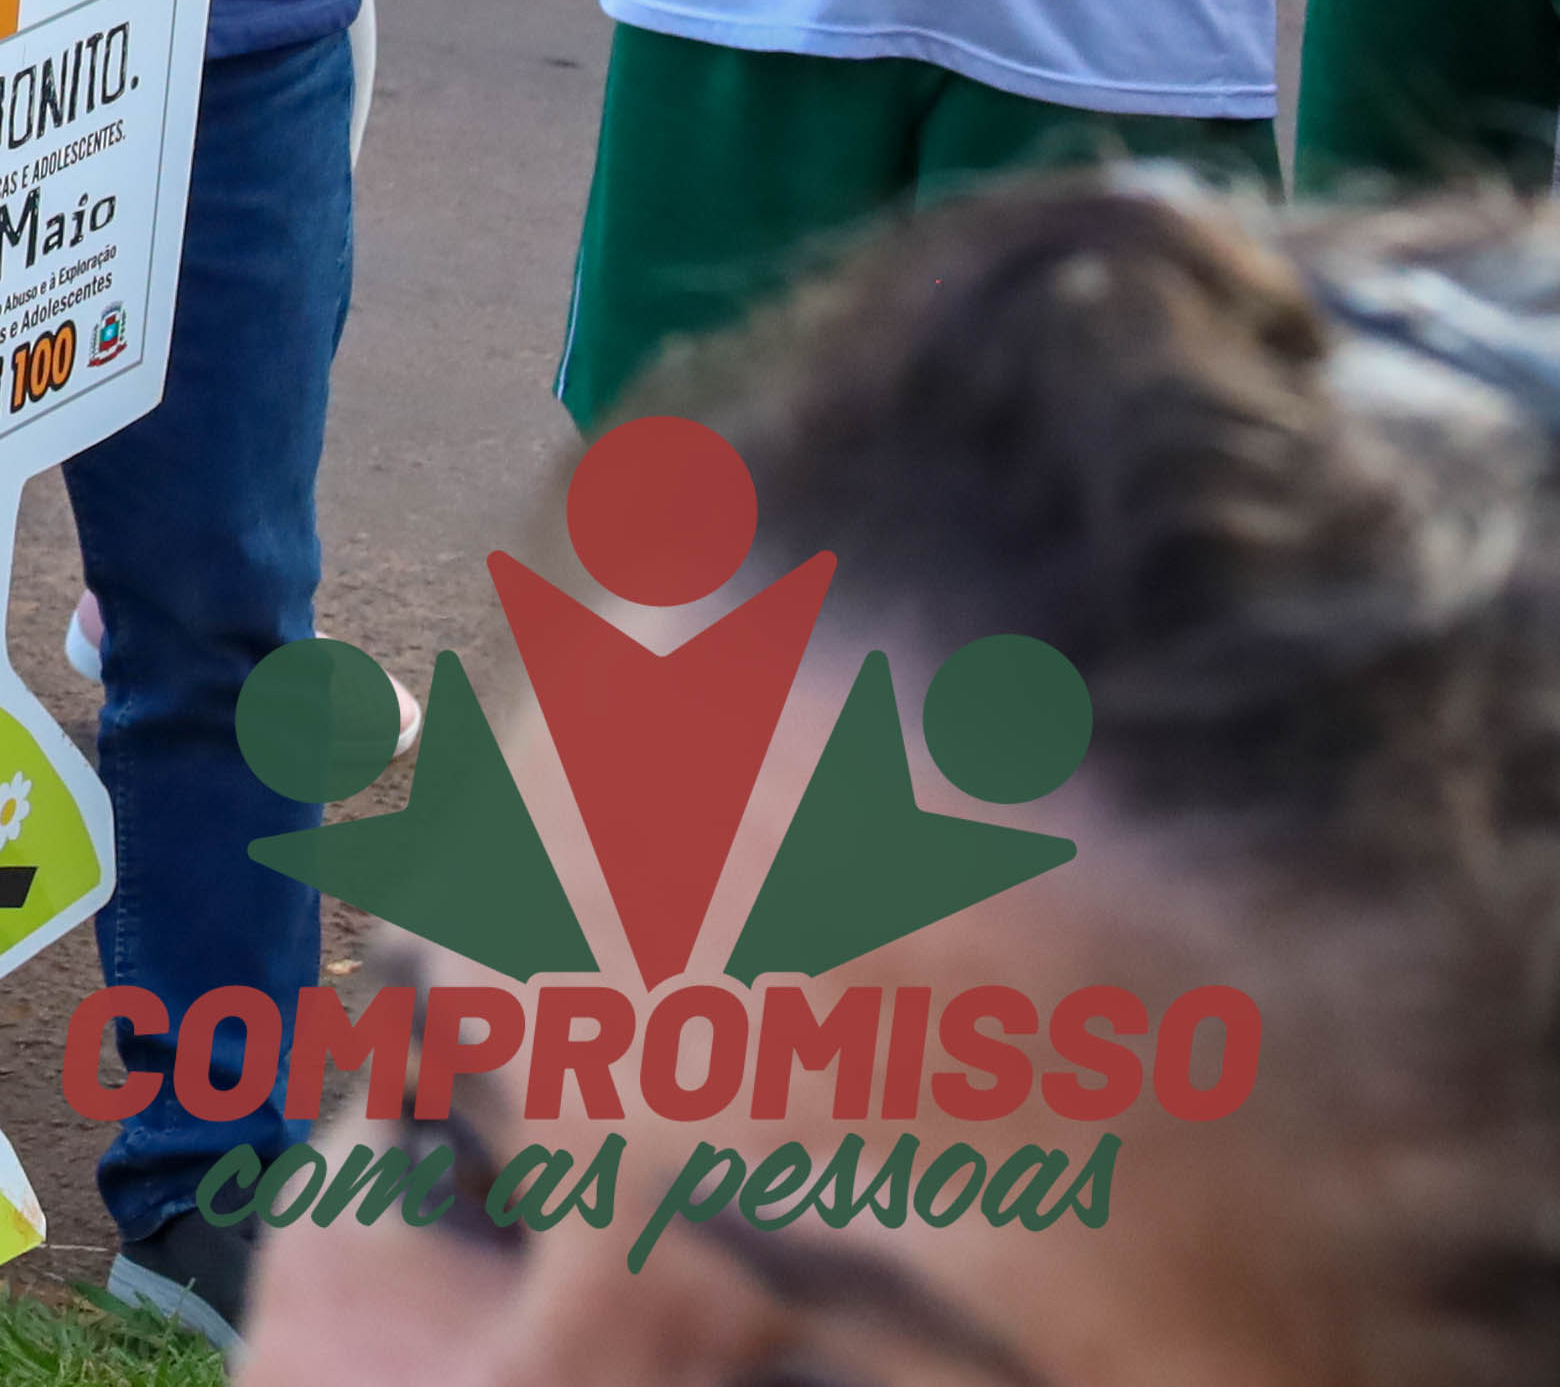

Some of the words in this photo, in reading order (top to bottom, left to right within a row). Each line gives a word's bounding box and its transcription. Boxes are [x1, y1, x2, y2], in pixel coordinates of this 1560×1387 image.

[21, 164, 29, 189] E
[4, 286, 38, 314] Abuso
[40, 280, 47, 295] e
[49, 272, 56, 291] à
[59, 245, 117, 285] Exploração
[10, 320, 18, 338] e
[21, 272, 113, 334] Adolescentes
[10, 319, 77, 414] 100
